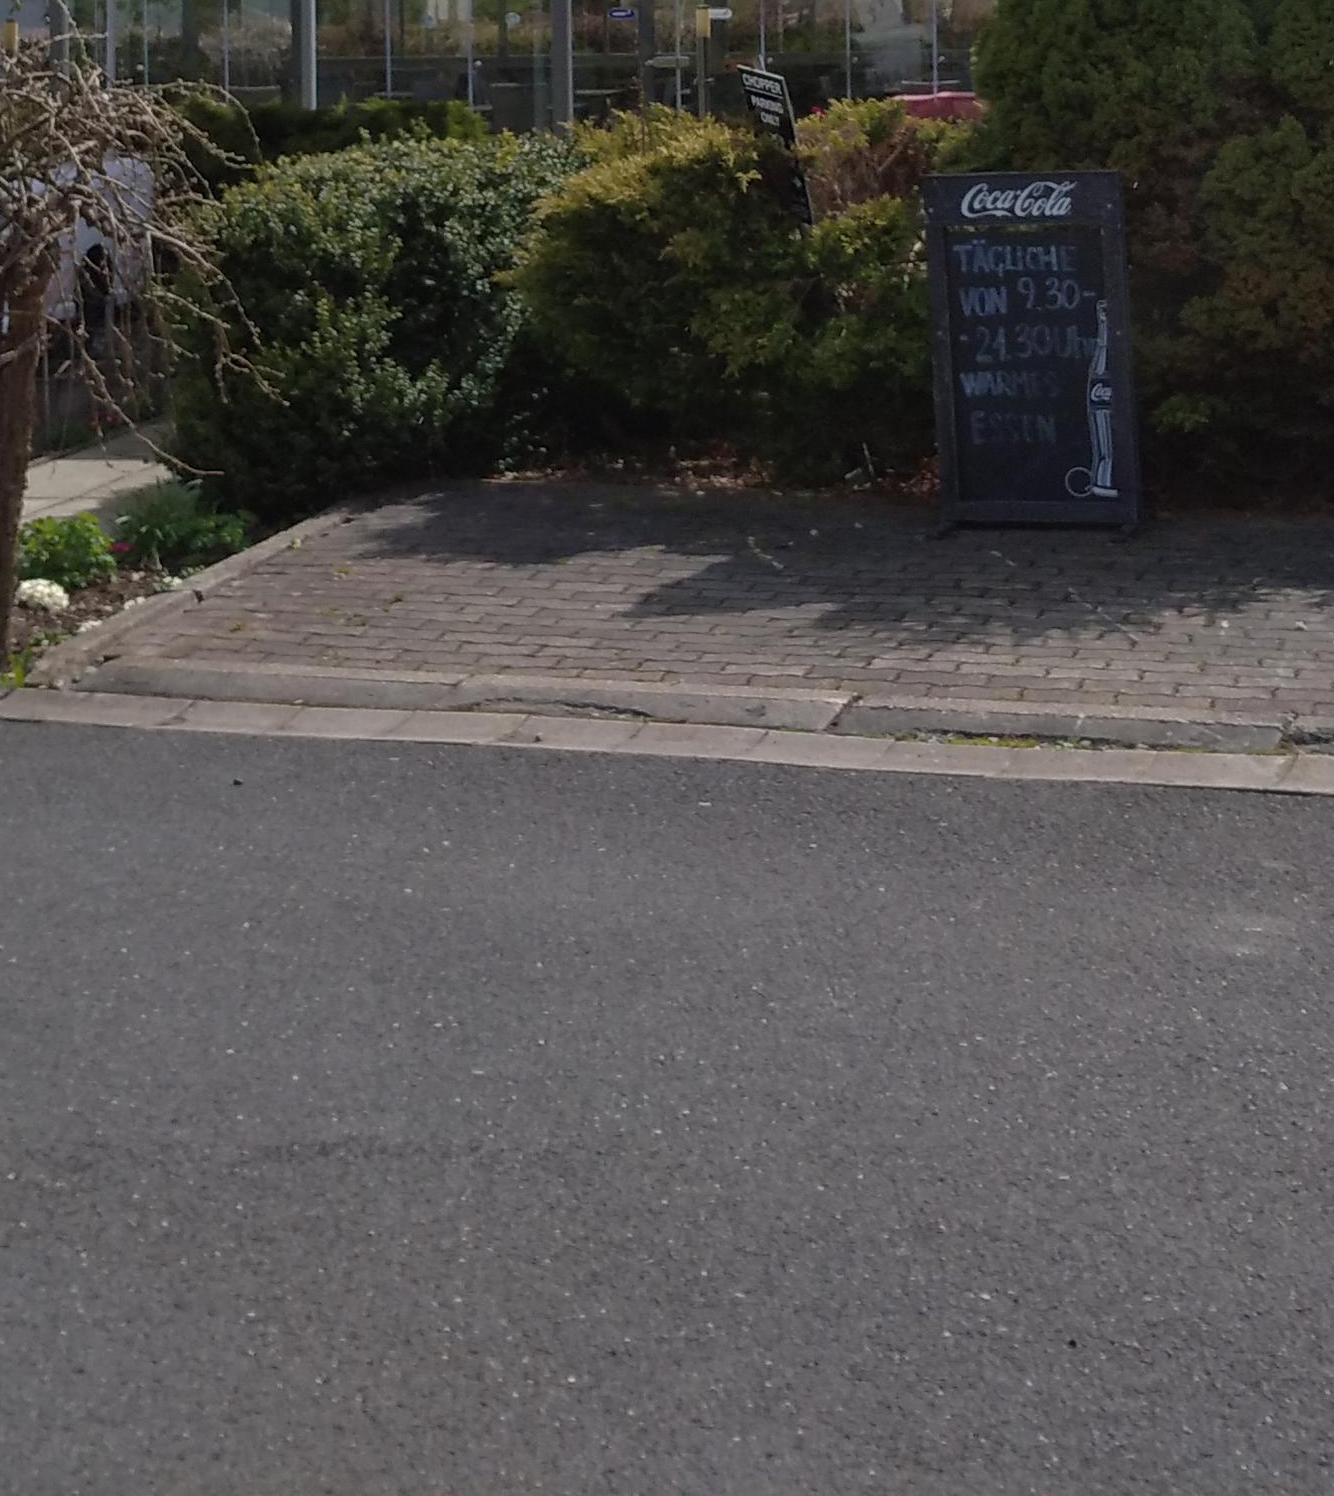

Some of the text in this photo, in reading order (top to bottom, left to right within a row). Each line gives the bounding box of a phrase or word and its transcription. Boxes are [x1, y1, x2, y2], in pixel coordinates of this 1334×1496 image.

[741, 72, 783, 95] CHOPPER
[760, 111, 781, 127] ONLY
[958, 285, 1009, 317] VON
